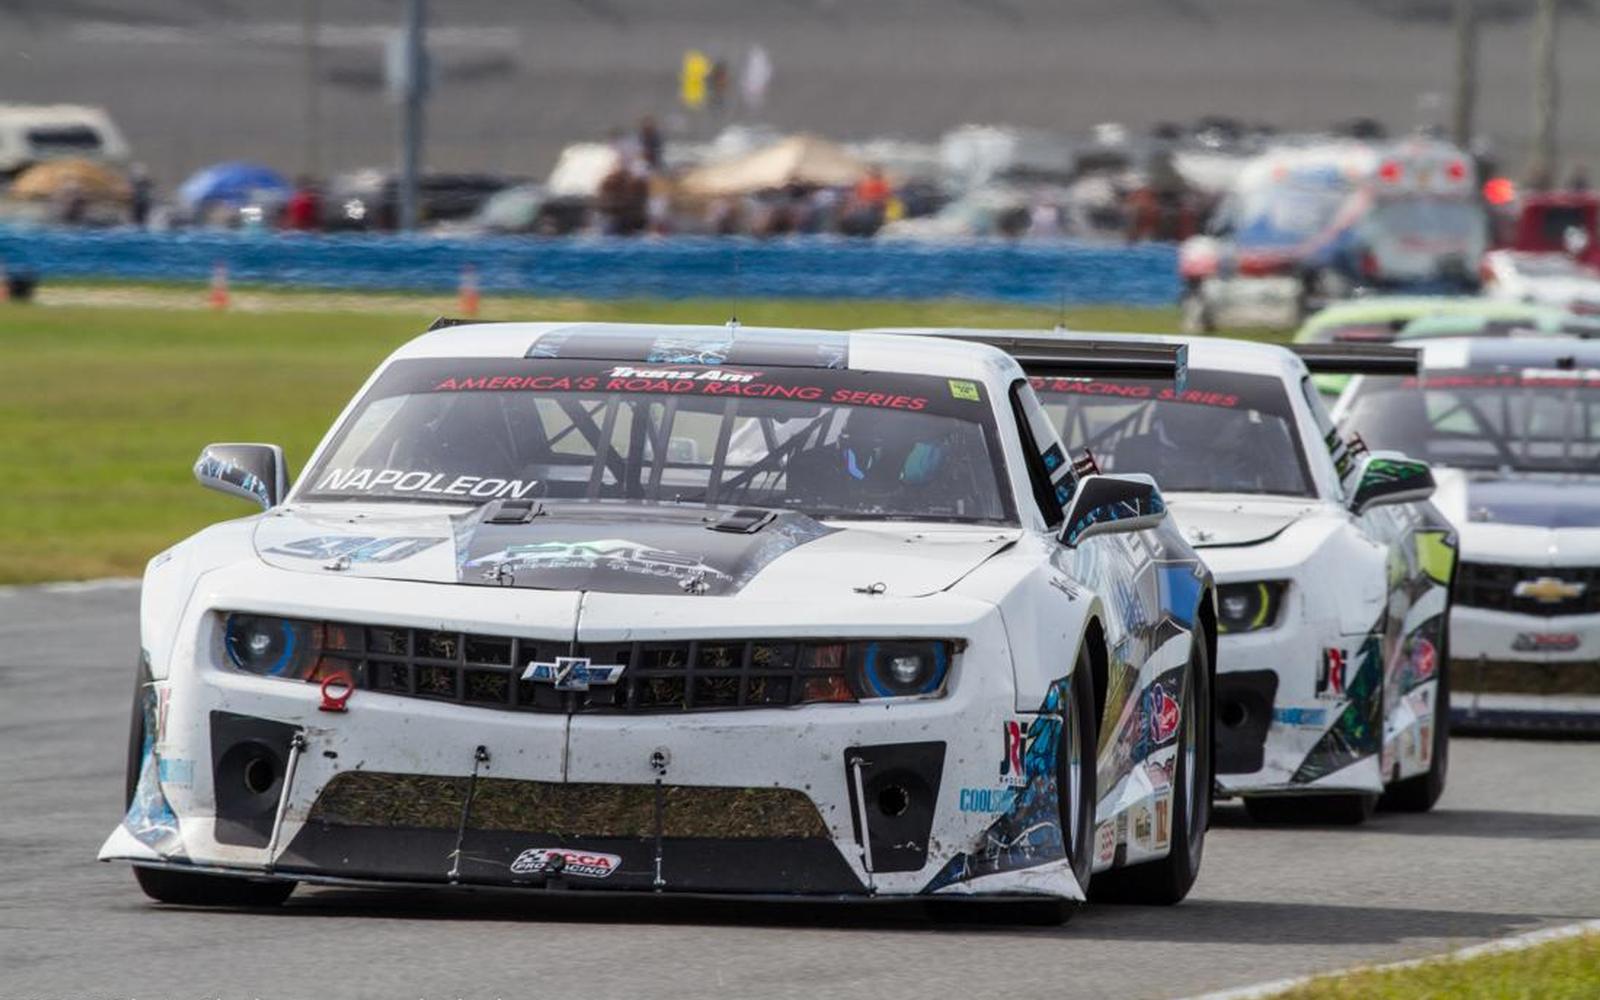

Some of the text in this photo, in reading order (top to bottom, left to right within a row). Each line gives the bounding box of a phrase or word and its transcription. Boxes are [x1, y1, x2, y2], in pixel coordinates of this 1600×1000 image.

[436, 376, 599, 392] AMERICA'S
[606, 379, 695, 392] ROAD
[703, 382, 822, 399] RACING
[831, 389, 929, 410] SERIES
[1051, 379, 1151, 397] RACING
[317, 468, 538, 498] NAPOLEON
